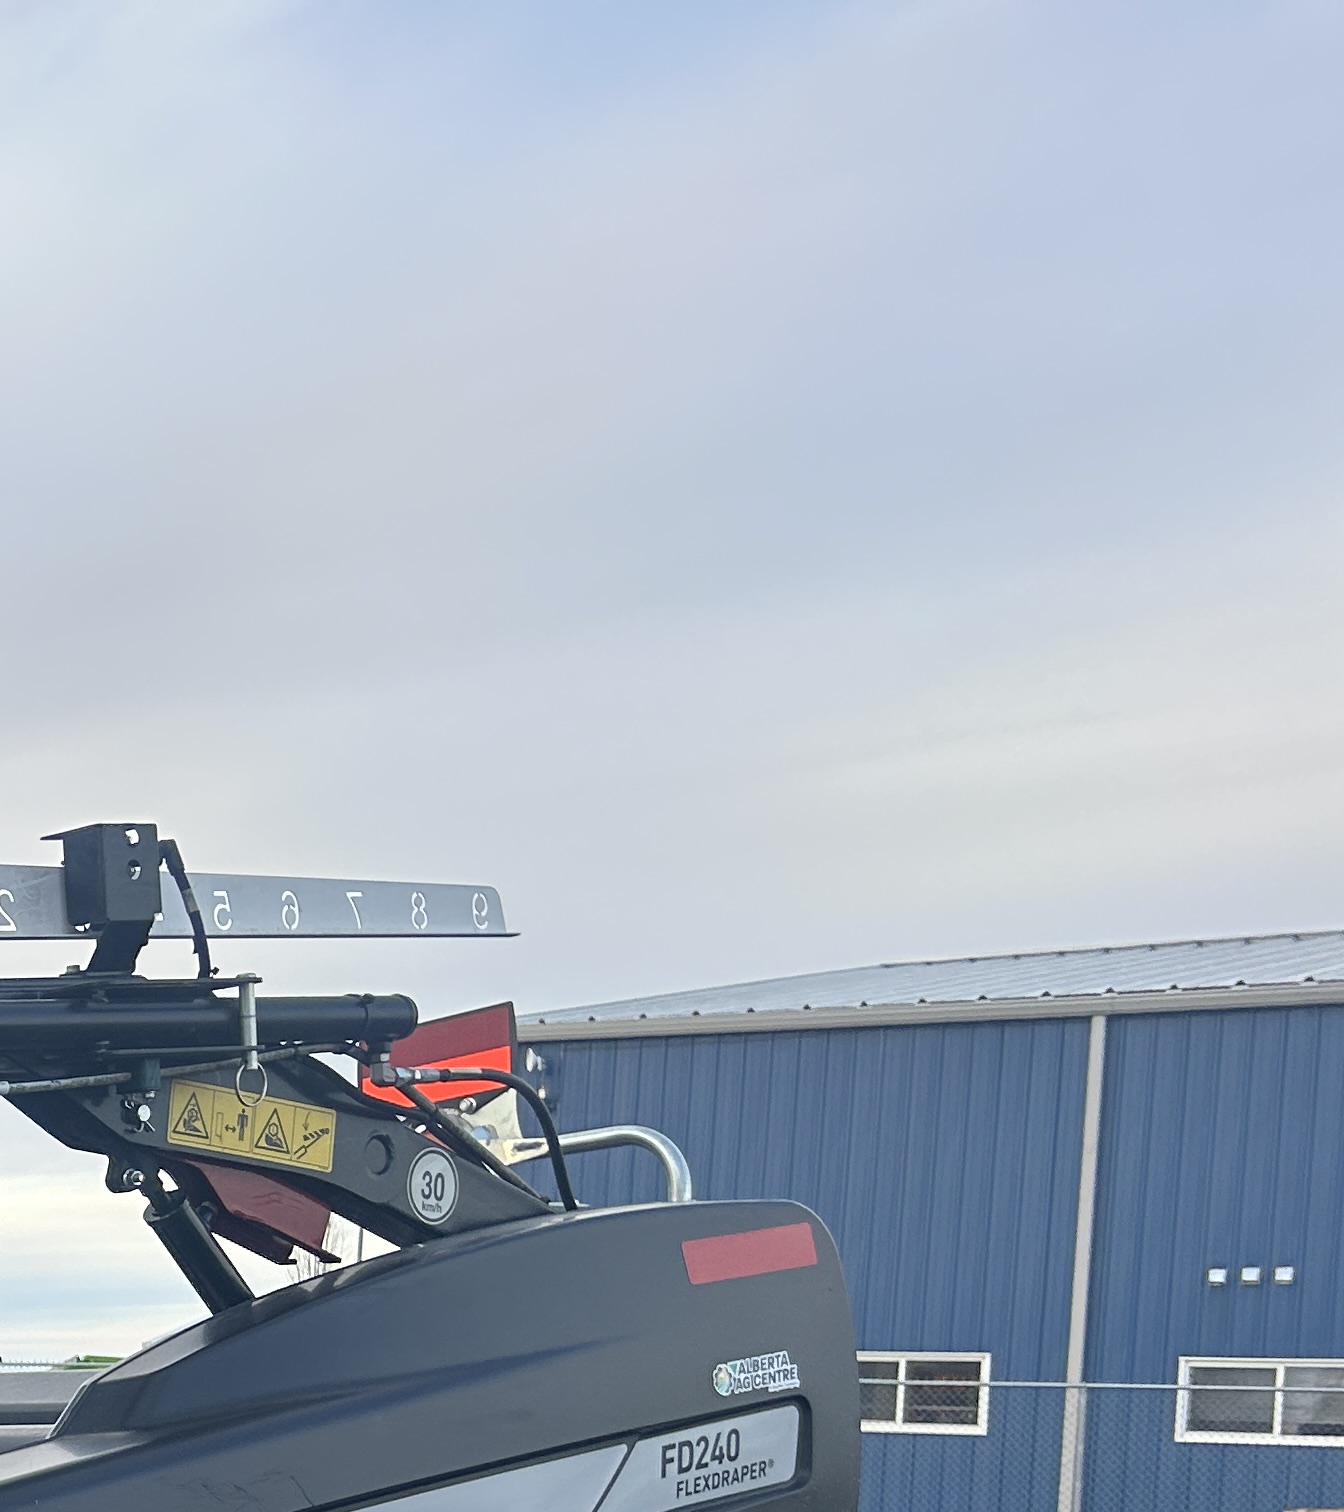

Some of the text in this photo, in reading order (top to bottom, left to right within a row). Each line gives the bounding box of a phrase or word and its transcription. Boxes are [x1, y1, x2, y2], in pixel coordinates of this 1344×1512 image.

[420, 1170, 445, 1202] 30
[421, 1200, 443, 1214] km/h
[737, 1353, 789, 1375] ALBERTA
[753, 1366, 796, 1387] CENTRE
[660, 1427, 740, 1479] FD240
